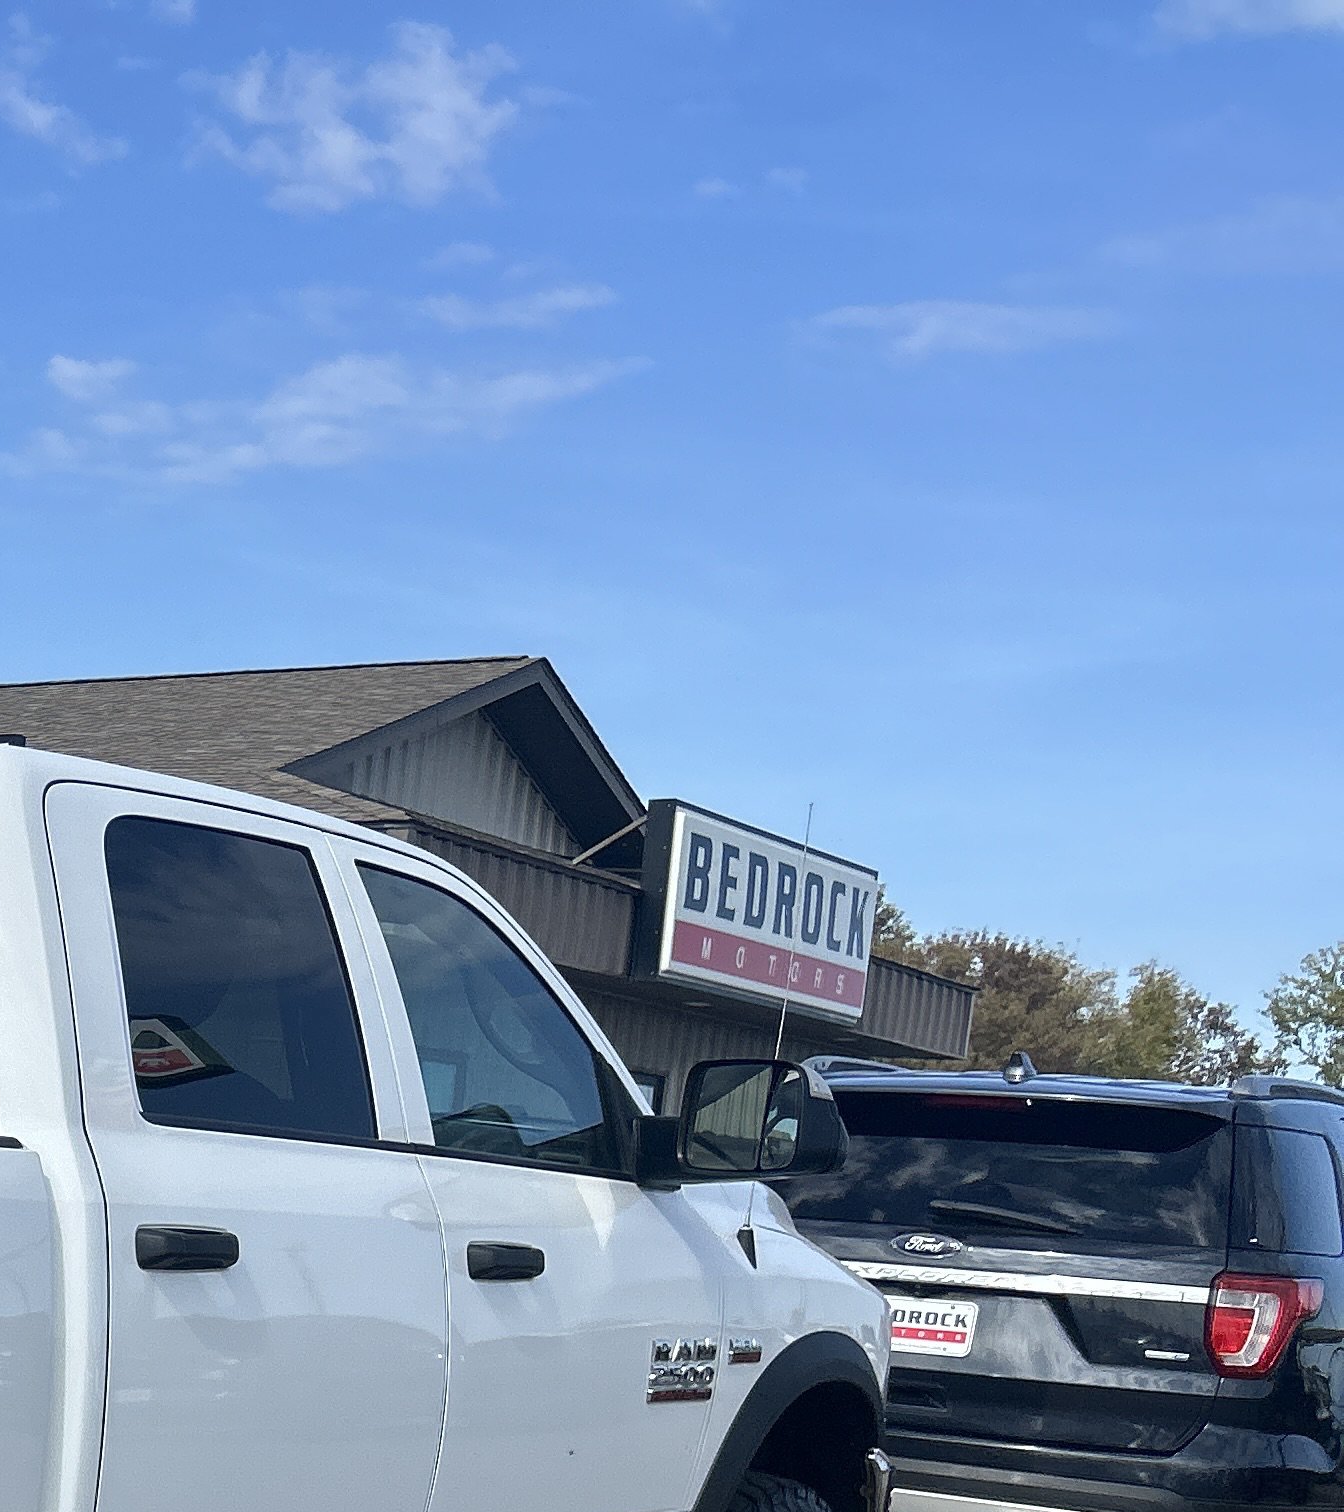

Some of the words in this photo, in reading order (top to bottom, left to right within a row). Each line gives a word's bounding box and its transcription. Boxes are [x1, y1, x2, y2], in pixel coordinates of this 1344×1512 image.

[683, 832, 870, 960] BEDROCK
[700, 937, 845, 995] MOTORS
[904, 1235, 945, 1253] Ford
[892, 1309, 968, 1329] DROCK
[647, 1363, 715, 1386] 2500
